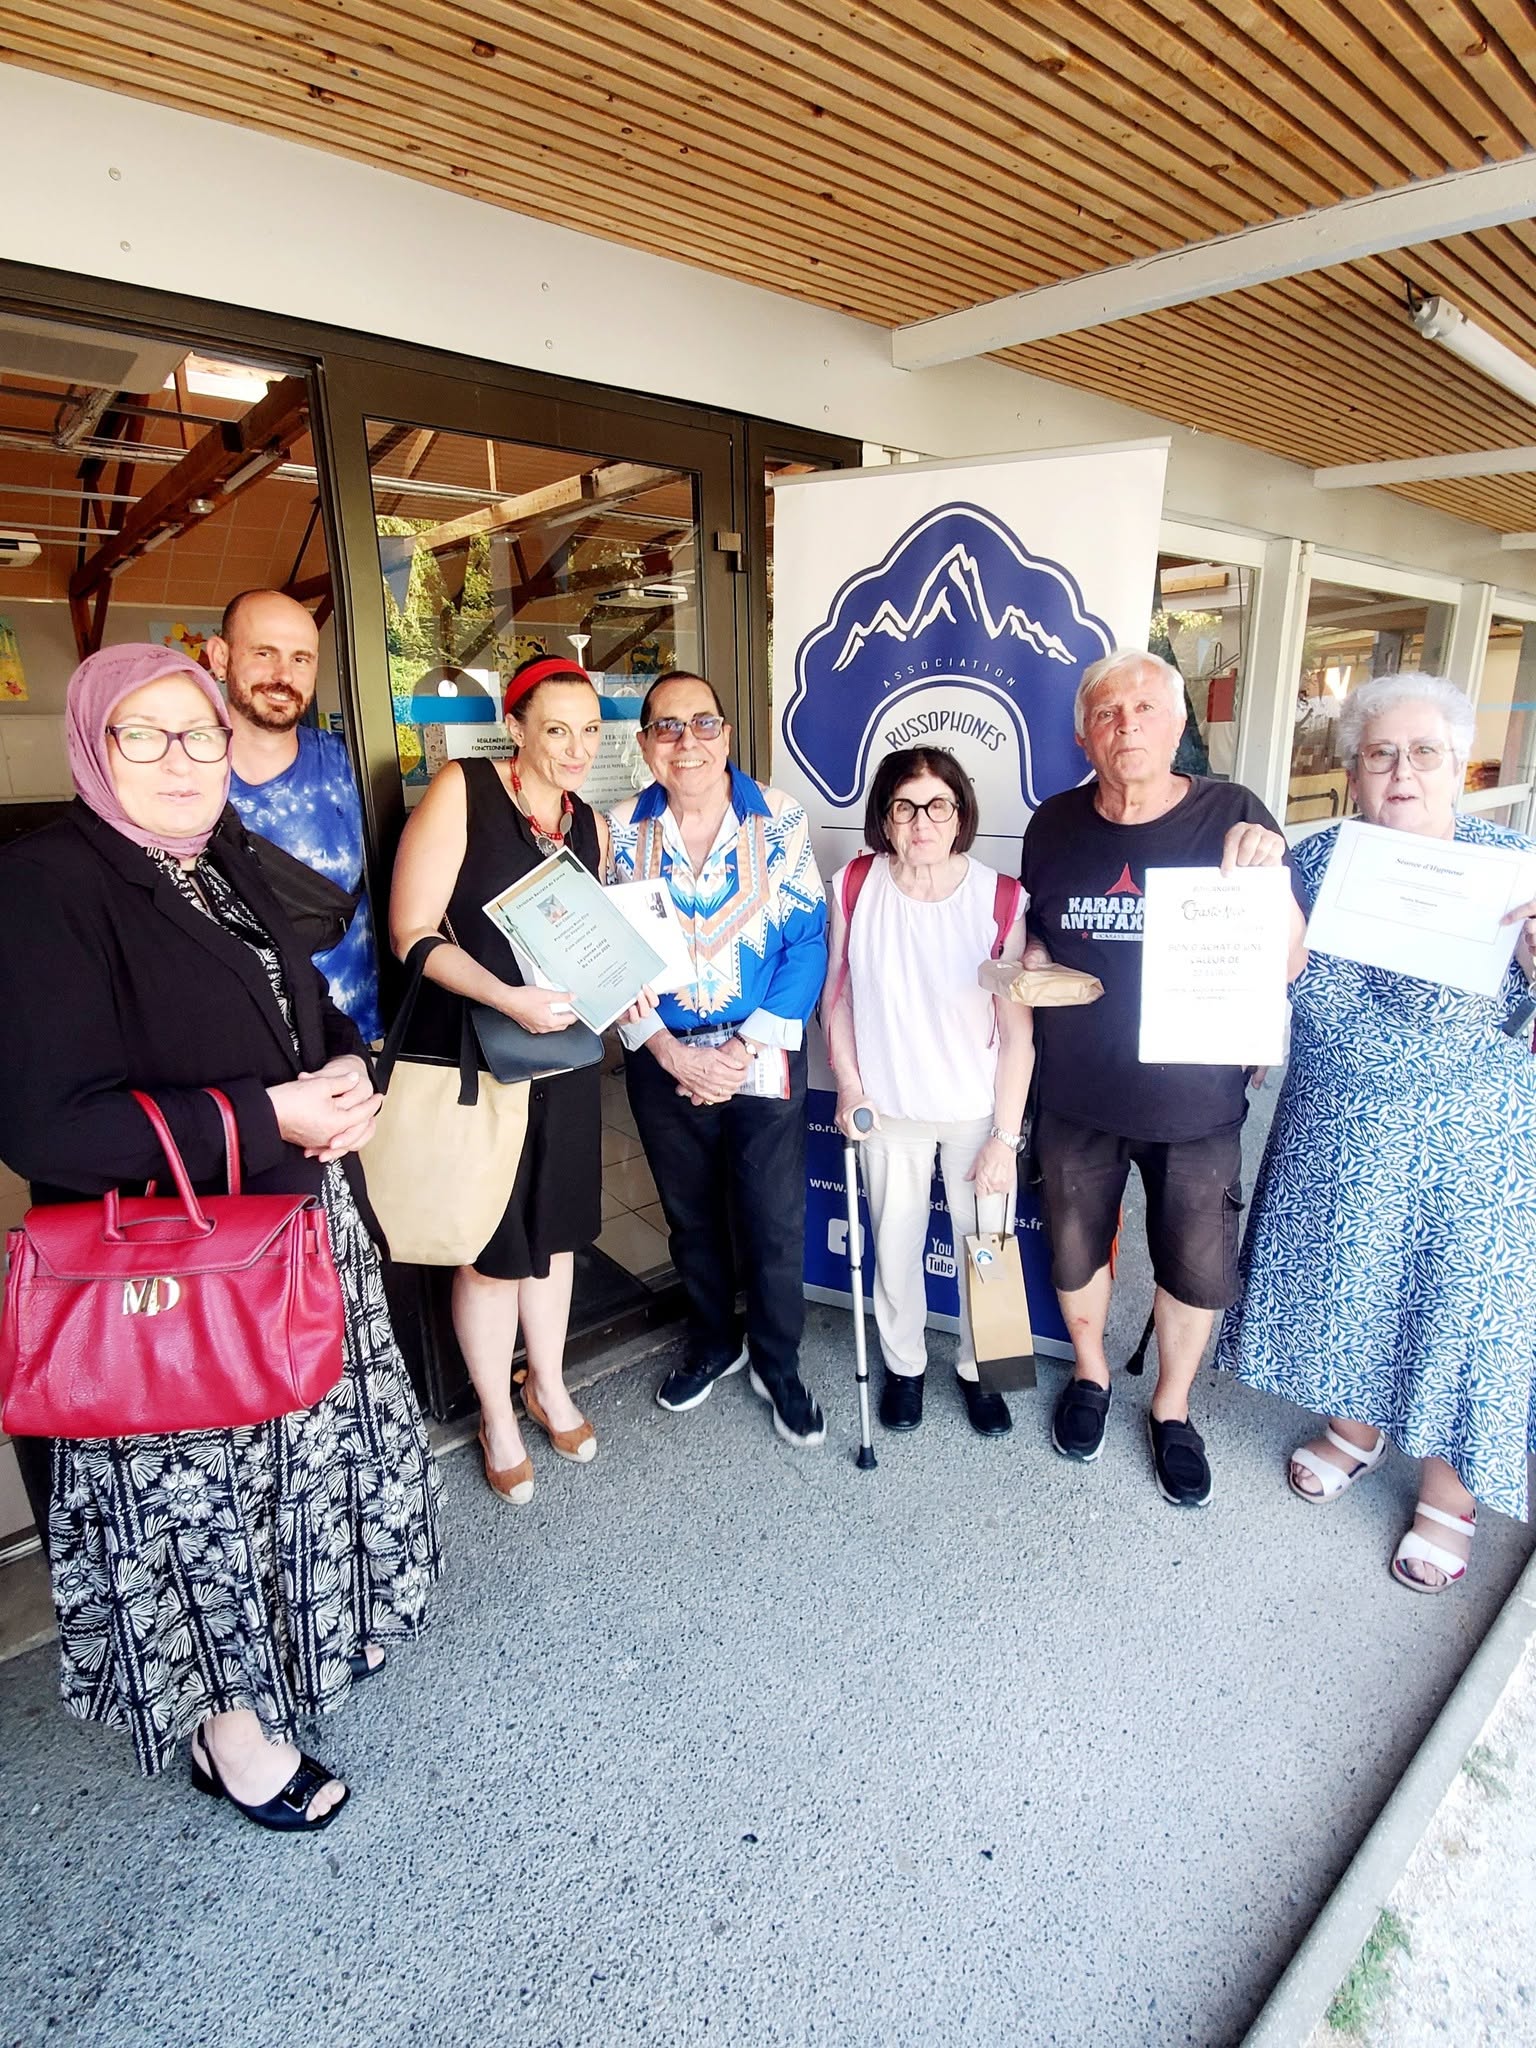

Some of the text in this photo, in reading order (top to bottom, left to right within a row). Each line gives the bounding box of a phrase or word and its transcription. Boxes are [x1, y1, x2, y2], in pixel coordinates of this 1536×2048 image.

[883, 658, 1016, 688] ASSOCIATION
[885, 711, 1007, 751] RUSSOPHONES
[932, 1238, 952, 1256] You
[929, 1257, 954, 1275] Tube
